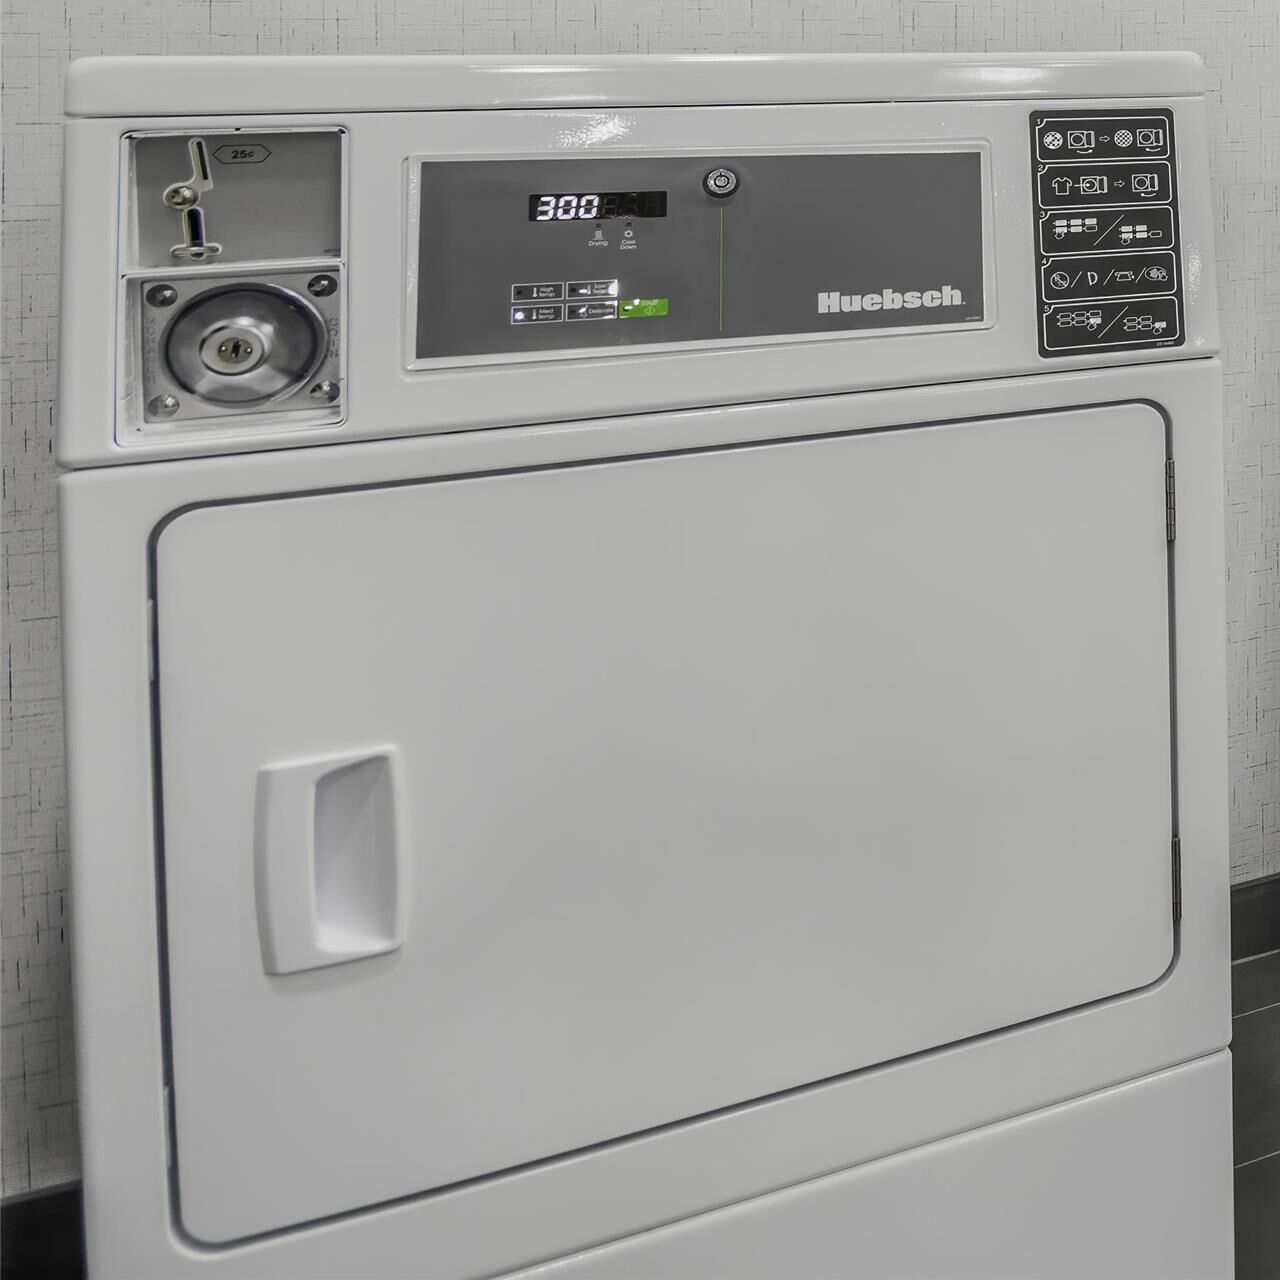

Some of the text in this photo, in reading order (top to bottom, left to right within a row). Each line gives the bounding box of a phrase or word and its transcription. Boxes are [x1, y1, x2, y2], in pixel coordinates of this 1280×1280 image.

[1038, 163, 1044, 171] 2
[1039, 210, 1045, 218] 3
[1041, 257, 1047, 265] 4
[817, 285, 963, 314] Huebsch
